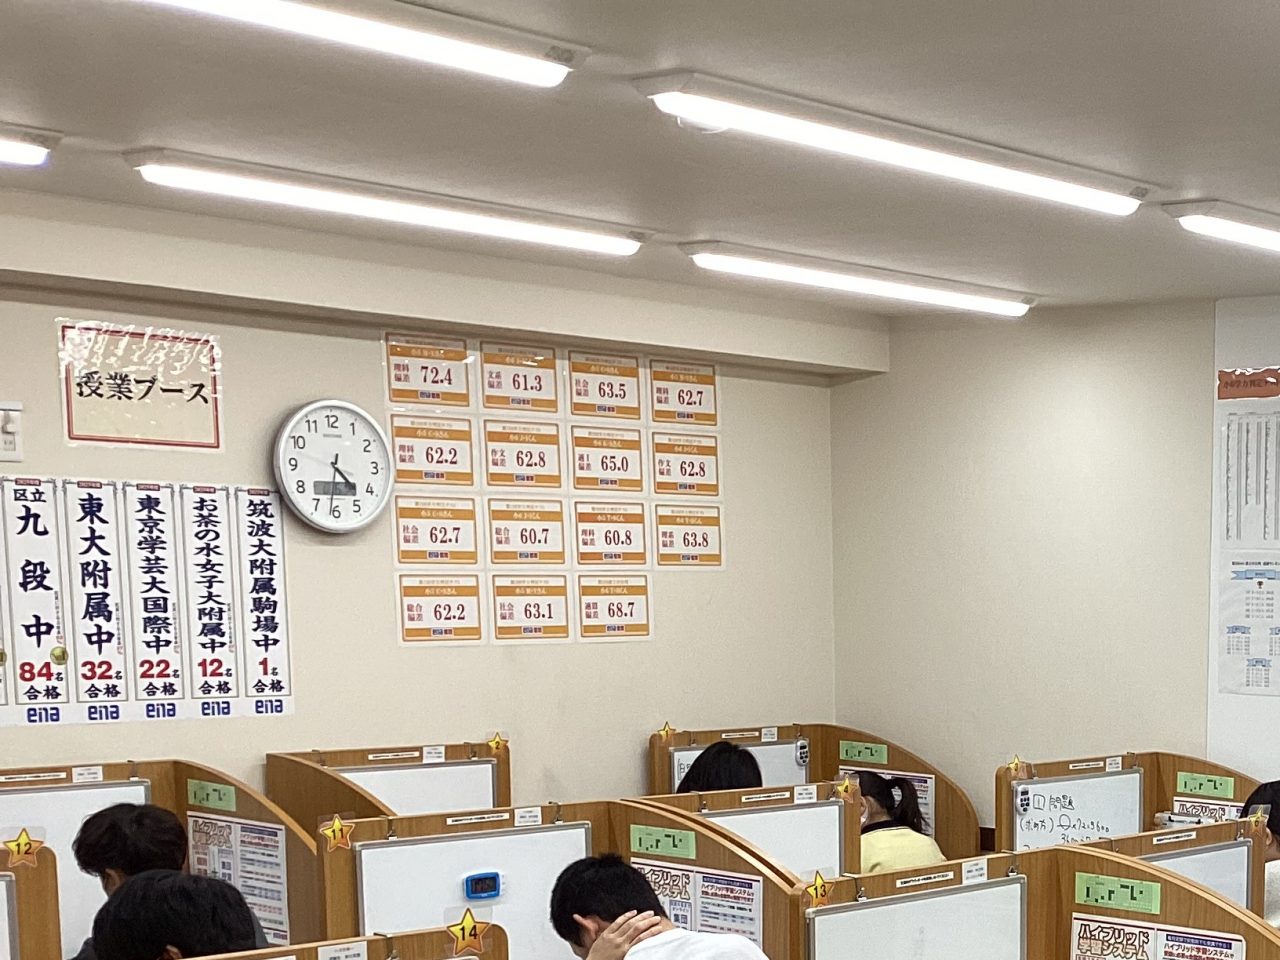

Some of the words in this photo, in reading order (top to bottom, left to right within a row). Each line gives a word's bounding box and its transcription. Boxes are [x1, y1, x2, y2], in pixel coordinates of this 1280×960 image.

[420, 366, 453, 385] 72.4
[512, 374, 542, 392] 61.3
[76, 371, 209, 404] 授業ブース
[598, 382, 626, 399] 63.5
[677, 390, 704, 406] 62.7
[306, 419, 318, 433] 11
[325, 415, 340, 429] 12
[350, 422, 356, 435] 1
[290, 435, 305, 449] 10
[363, 439, 372, 453] 2
[288, 457, 298, 471] 9
[425, 447, 458, 465] 62.2
[516, 450, 546, 468] 62.8
[601, 455, 629, 472] 65.0
[370, 461, 379, 475] 3
[680, 462, 706, 478] 62.8
[296, 480, 305, 494] 8
[365, 482, 374, 496] 4
[14, 489, 46, 503] 区立
[312, 498, 320, 512] 7
[332, 505, 341, 519] 6
[353, 500, 361, 513] 5
[429, 527, 461, 544] 62.7
[520, 528, 550, 545] 60.7
[604, 530, 632, 546] 60.8
[683, 532, 709, 548] 63.8
[17, 505, 55, 648] 九段中
[76, 493, 115, 655] 東大附属中
[135, 494, 172, 654] 東京学芸大国際中
[192, 497, 227, 654] お茶の水女子大附属中
[247, 500, 280, 653] 筑波大附属駒場中
[433, 603, 466, 621] 62.2
[524, 603, 554, 620] 63.1
[607, 602, 635, 618] 68.7
[23, 684, 62, 700] 合格
[85, 684, 121, 699] 合格
[142, 682, 178, 697] 合格
[199, 680, 230, 695] 合格
[252, 679, 285, 693] 合格
[27, 706, 60, 723] ena
[88, 705, 120, 720] ena
[146, 702, 176, 718] ena
[201, 701, 230, 716] ena
[255, 699, 283, 714] ena
[331, 828, 344, 840] 11
[16, 842, 32, 855] 12
[814, 885, 827, 899] 13
[459, 926, 478, 941] 14
[1078, 924, 1149, 944] ハイブリッド
[1077, 939, 1149, 960] 学習システム
